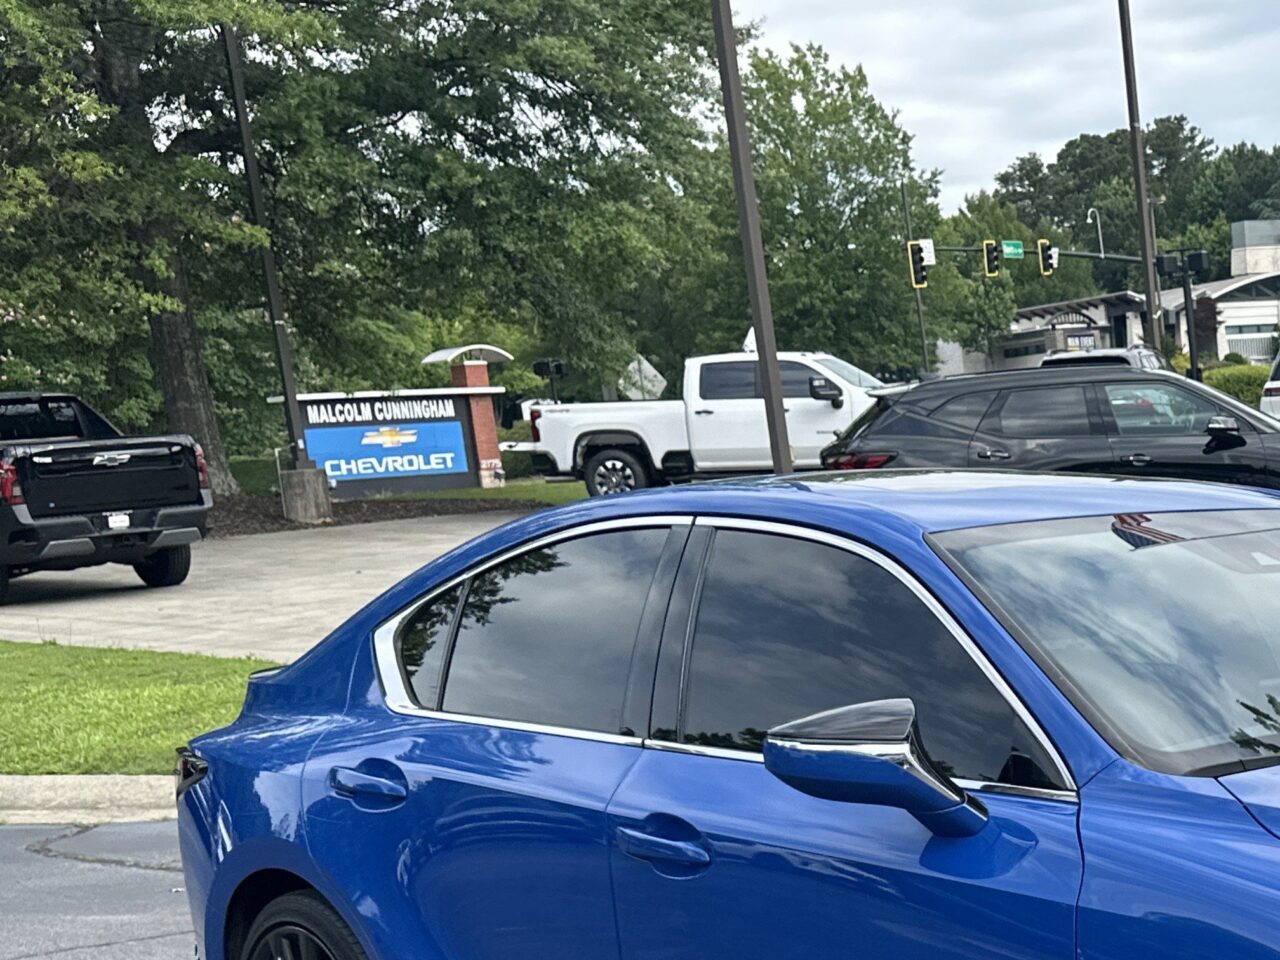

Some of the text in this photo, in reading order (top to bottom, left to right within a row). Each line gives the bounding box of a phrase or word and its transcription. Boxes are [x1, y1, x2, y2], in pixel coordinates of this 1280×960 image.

[307, 399, 456, 424] MALCOLM CUNNINGHAM
[324, 453, 455, 476] CHEVROLET
